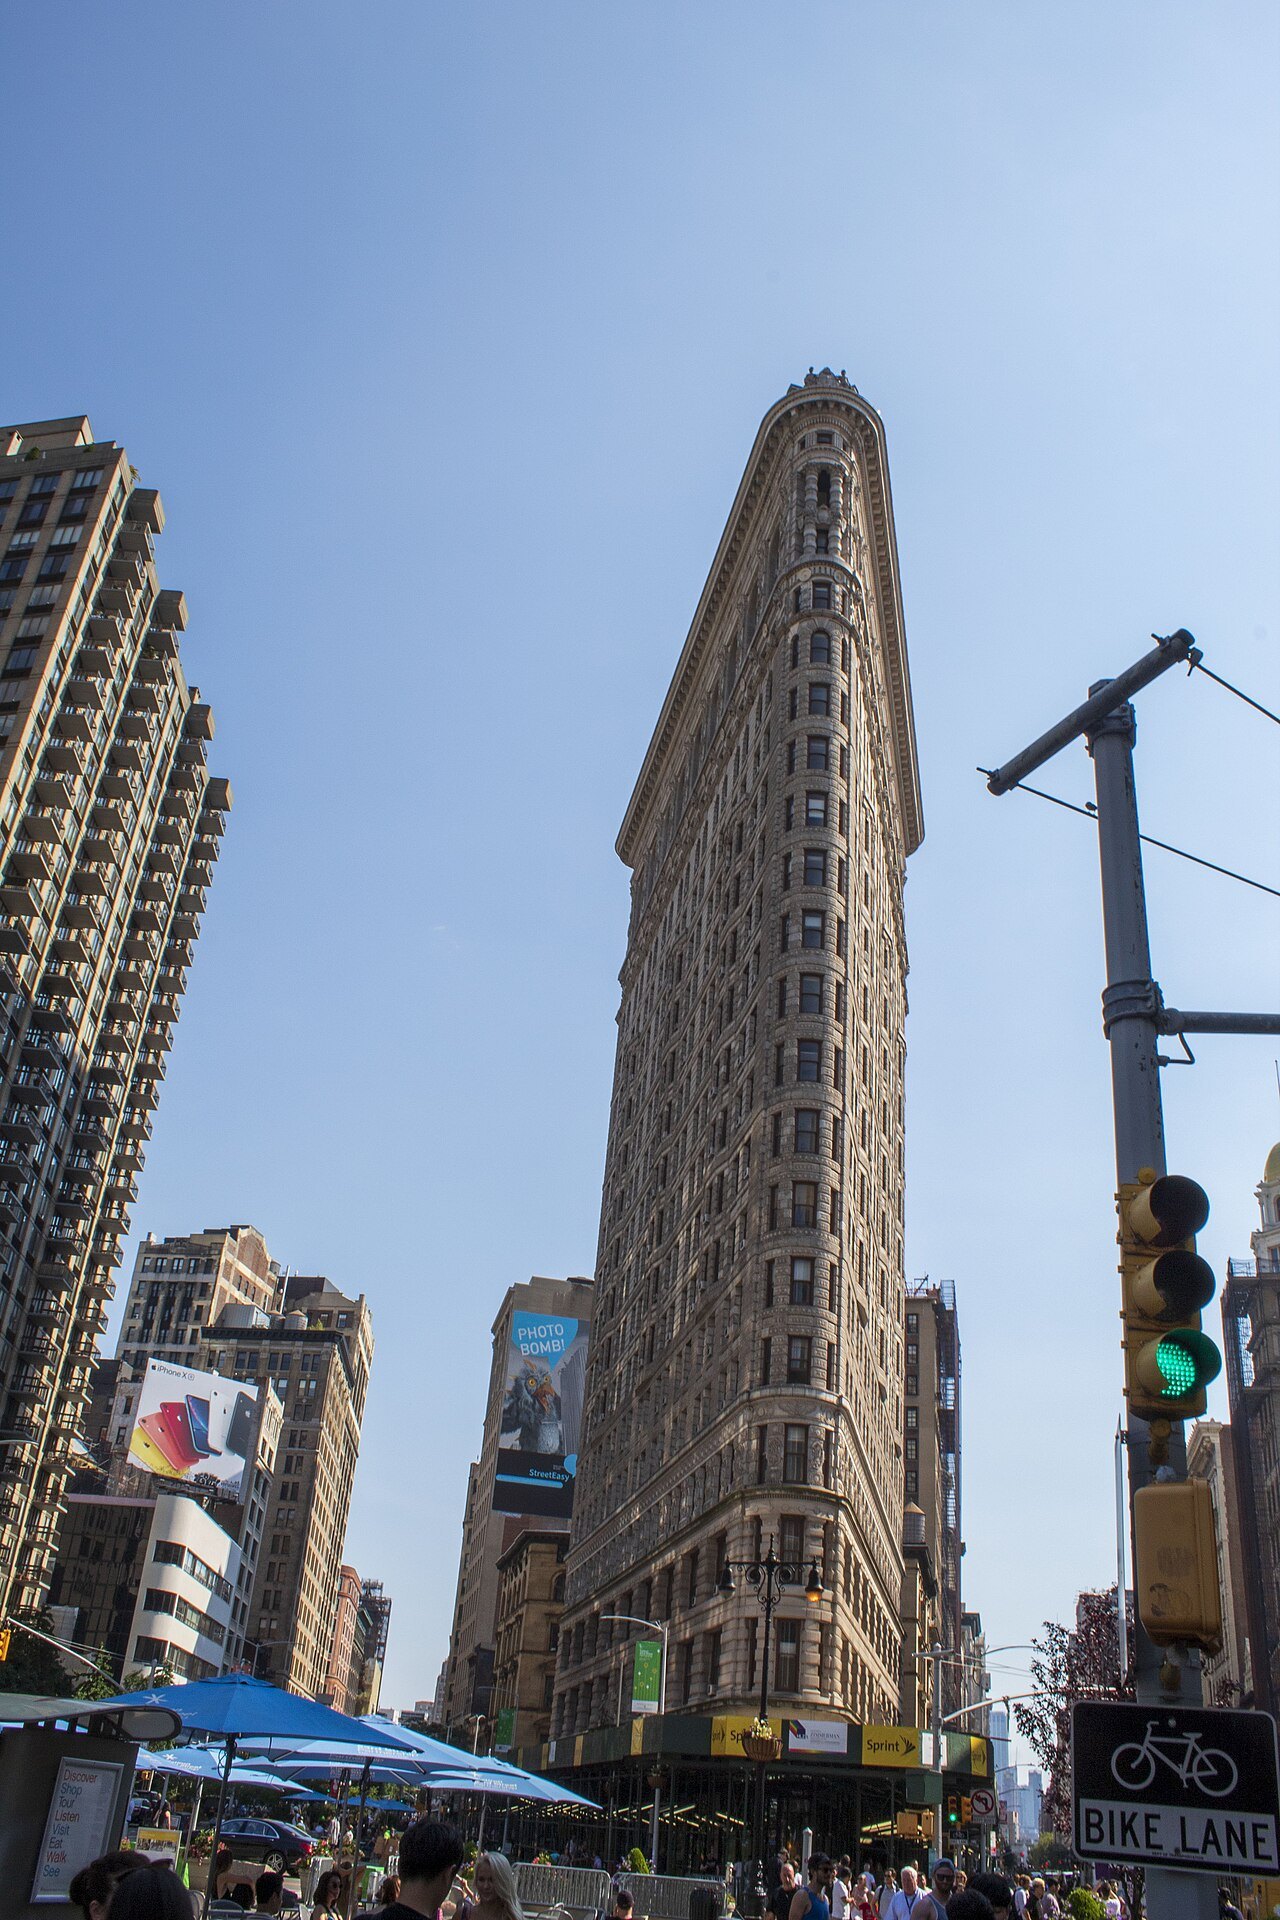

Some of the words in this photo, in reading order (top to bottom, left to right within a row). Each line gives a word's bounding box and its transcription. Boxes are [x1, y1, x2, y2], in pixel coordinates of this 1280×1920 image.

[518, 1323, 564, 1341] PHOTO
[520, 1339, 566, 1356] BOMB!
[157, 1365, 181, 1377] iPhone
[529, 1468, 570, 1482] StreetEasy
[866, 1739, 900, 1754] Sprint
[63, 1769, 98, 1784] Discover
[60, 1783, 82, 1798] Shop
[59, 1796, 75, 1808] Tour
[55, 1810, 80, 1822] Listen
[53, 1824, 70, 1836] Visit
[1085, 1808, 1164, 1850] BIKE
[1180, 1816, 1273, 1861] LANE
[49, 1837, 63, 1849] Eat
[47, 1852, 67, 1863] Walk
[43, 1865, 60, 1877] See
